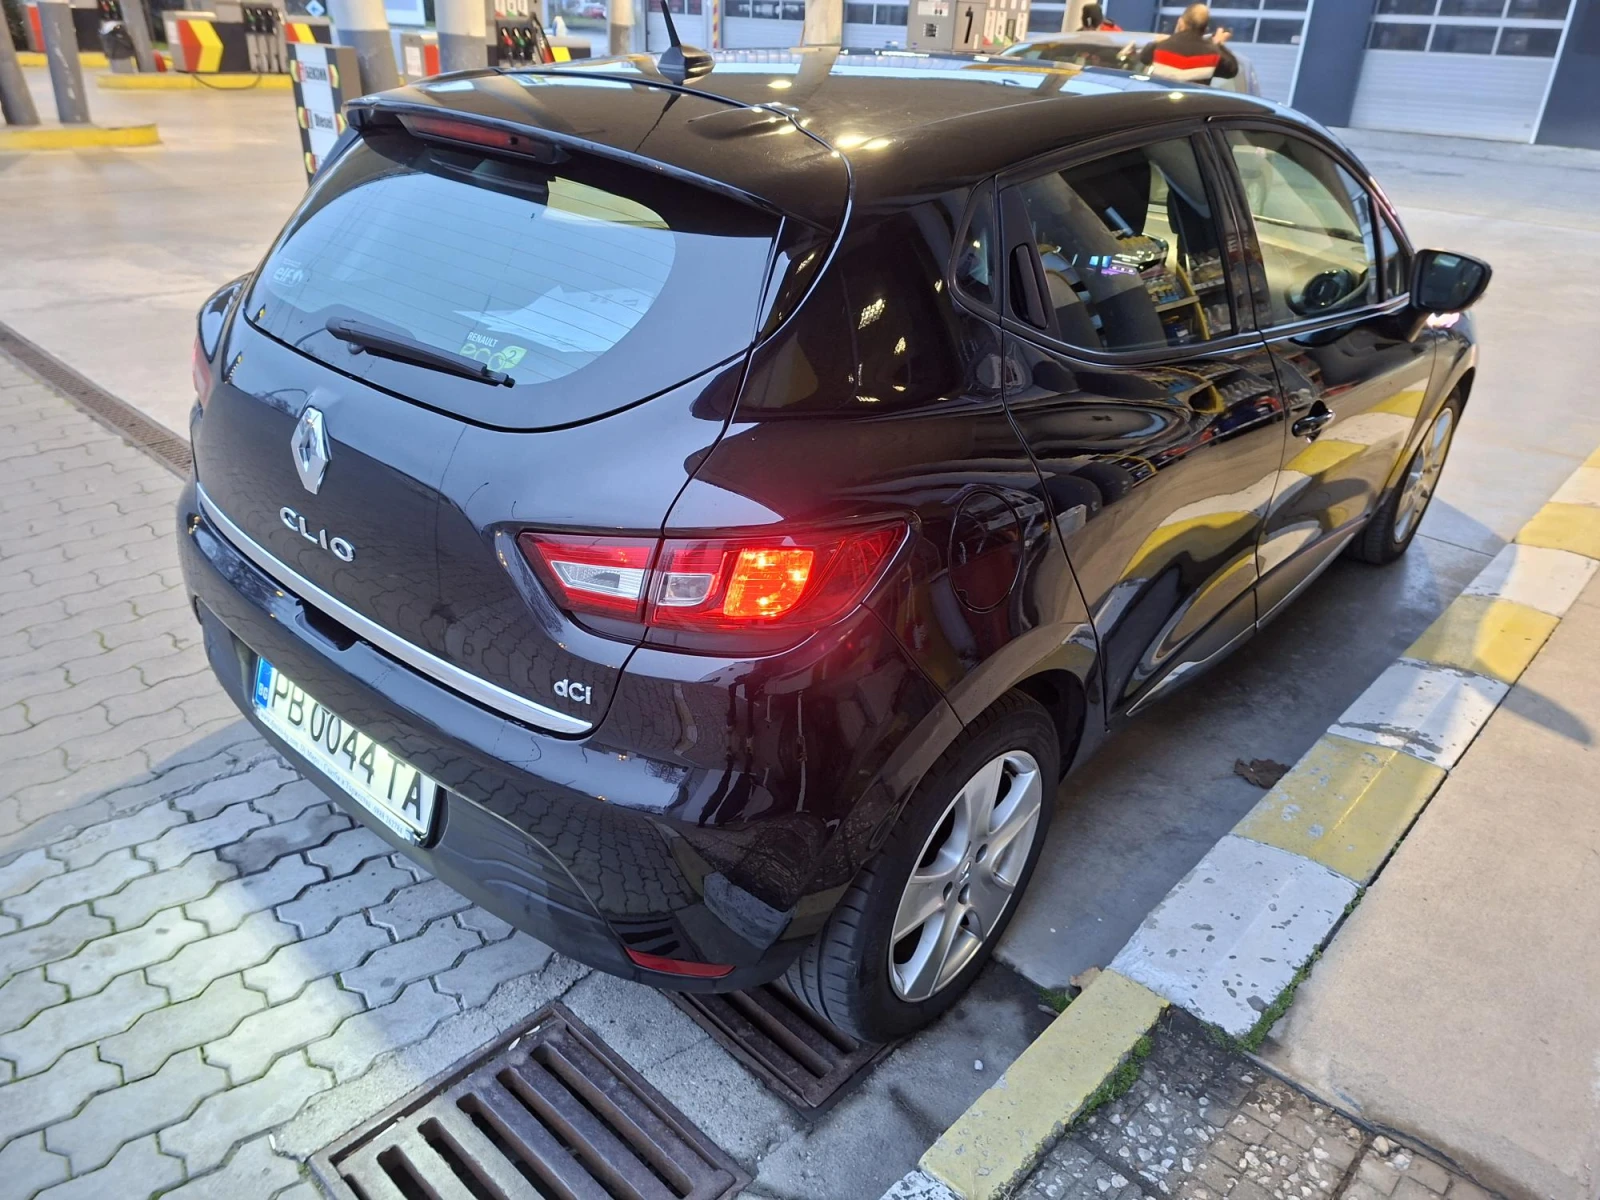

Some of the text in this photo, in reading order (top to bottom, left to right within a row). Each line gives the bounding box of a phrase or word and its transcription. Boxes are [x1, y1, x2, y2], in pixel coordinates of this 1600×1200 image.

[466, 331, 499, 348] RENAULT
[279, 506, 356, 562] CLIO
[257, 682, 269, 701] BG
